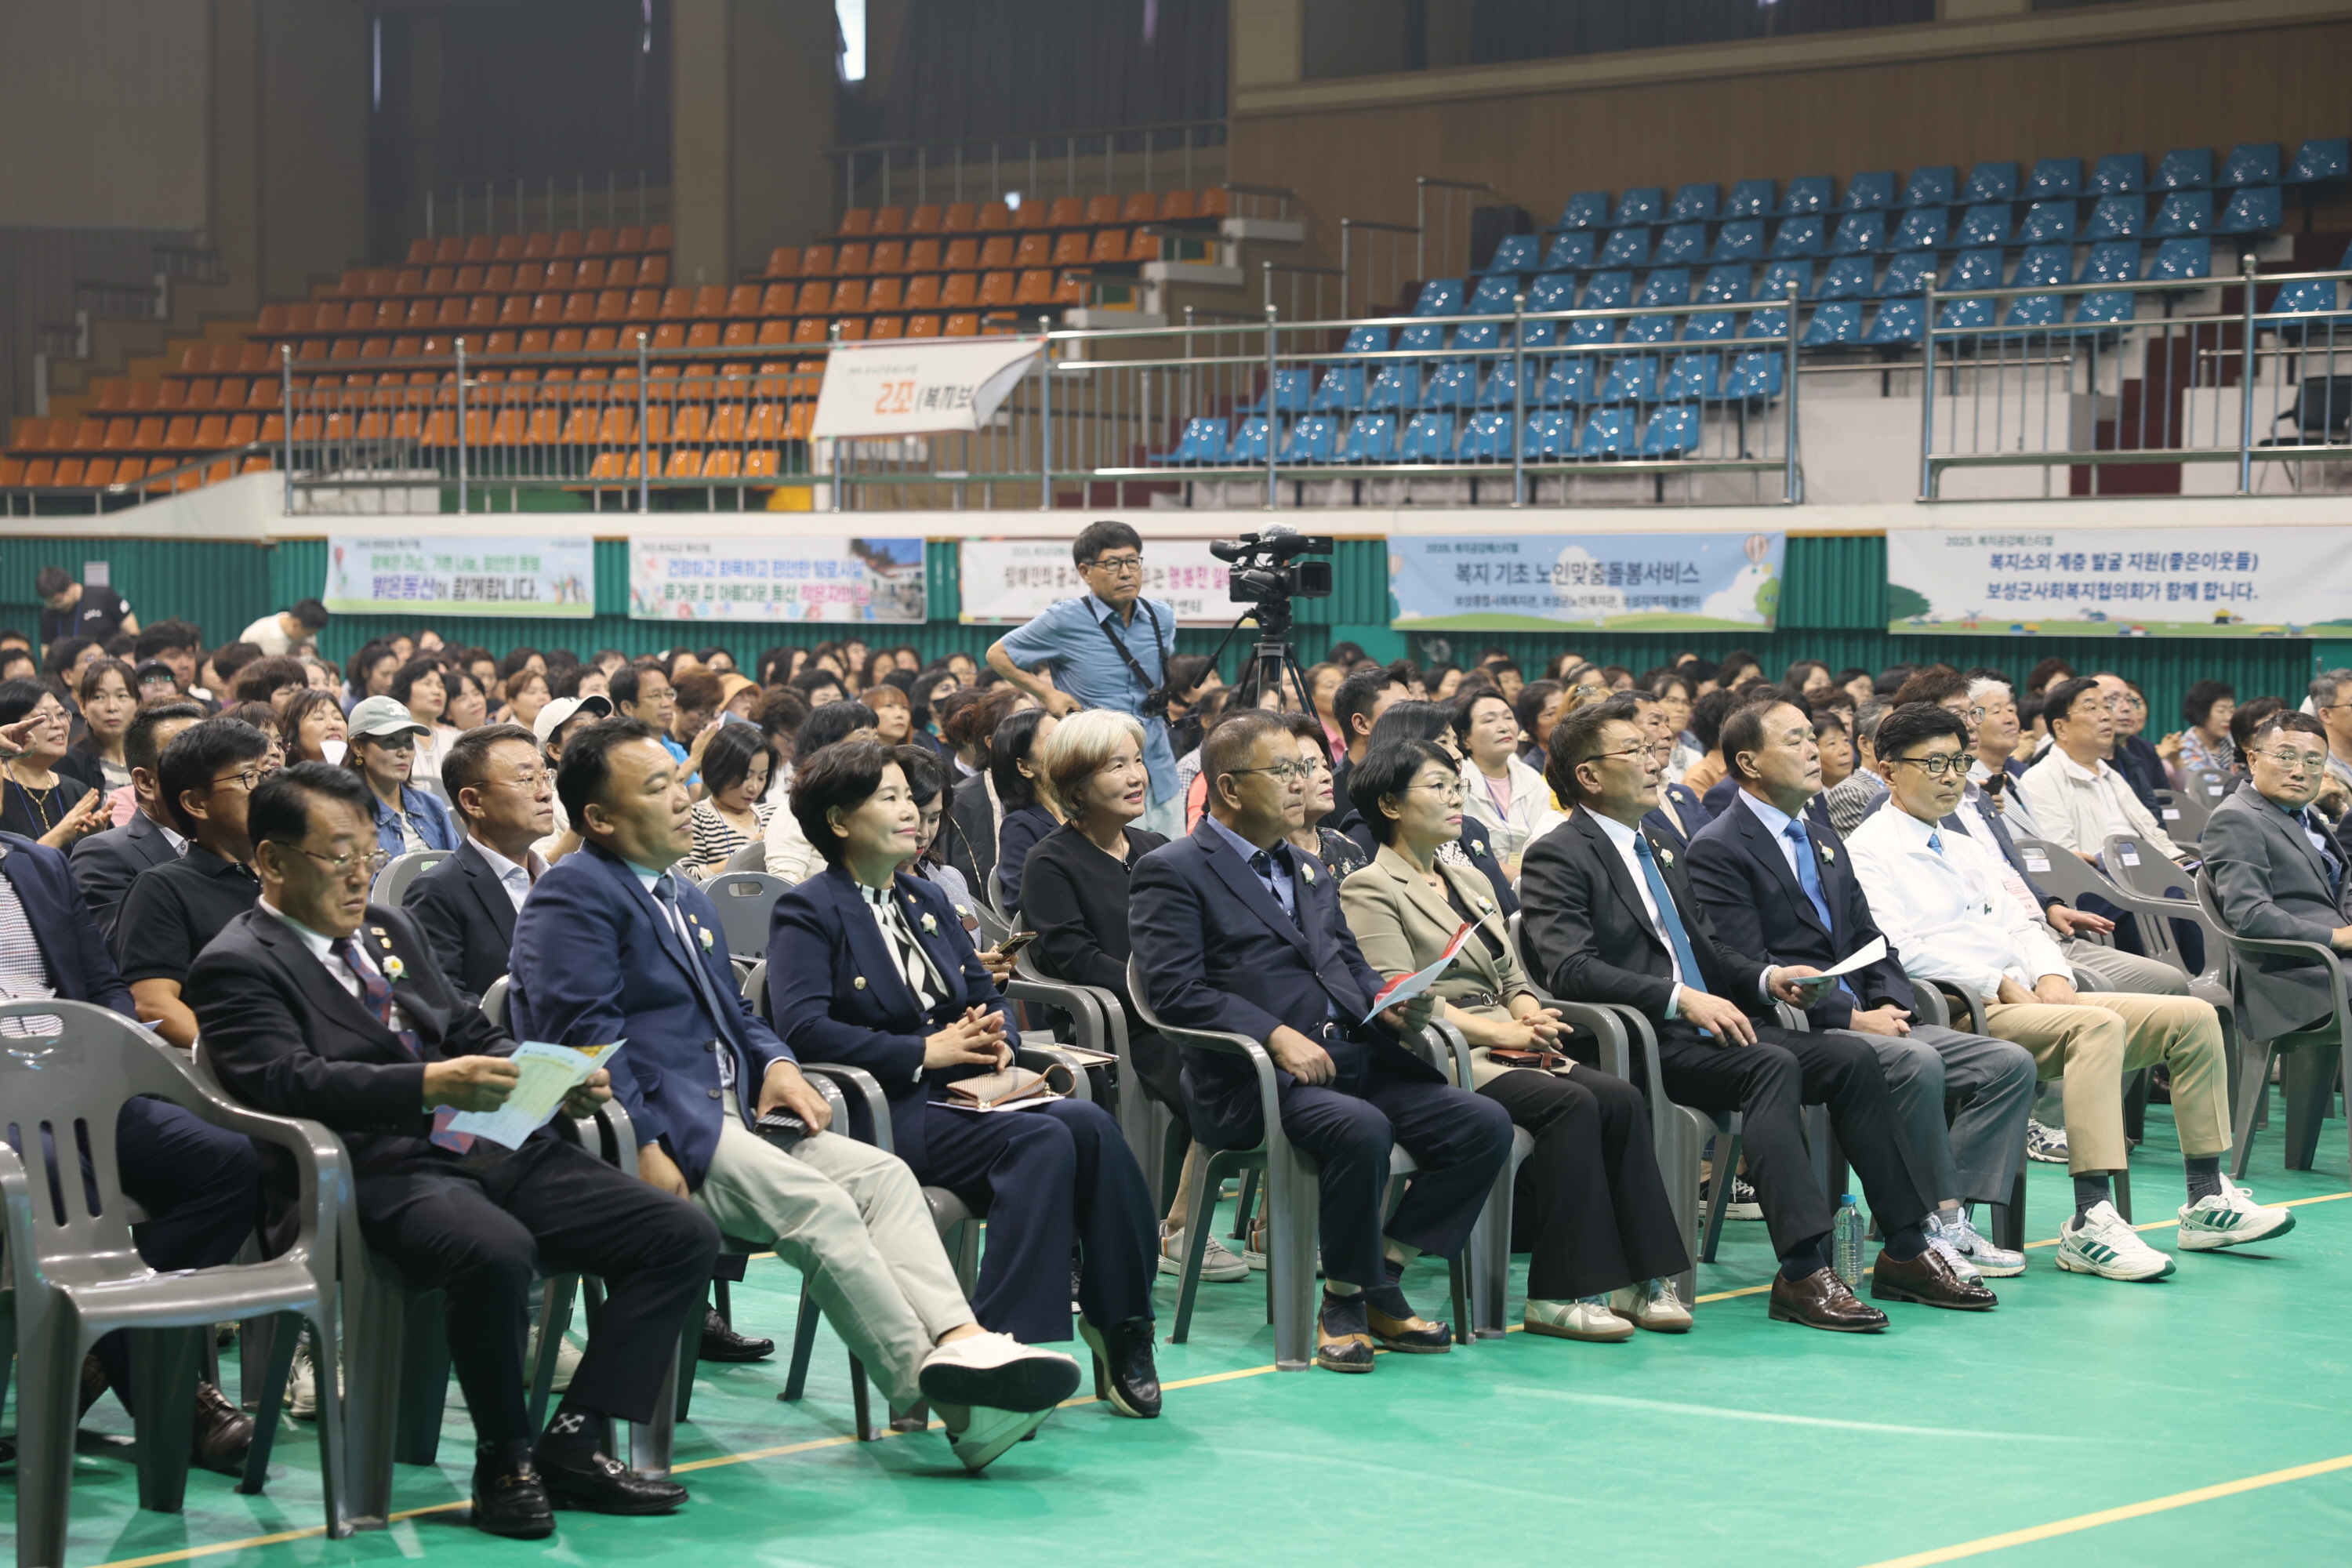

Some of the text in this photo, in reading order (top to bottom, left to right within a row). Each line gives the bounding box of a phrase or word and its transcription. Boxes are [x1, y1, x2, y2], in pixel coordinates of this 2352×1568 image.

[1990, 552, 2259, 572] 복지소외 계층 발굴 지원(좋은이웃들)
[1456, 562, 1700, 586] 복지 기초 노인맞춤돌봄서비스
[1987, 582, 2259, 602] 보성군사회복지협의회가 함께 합니다.
